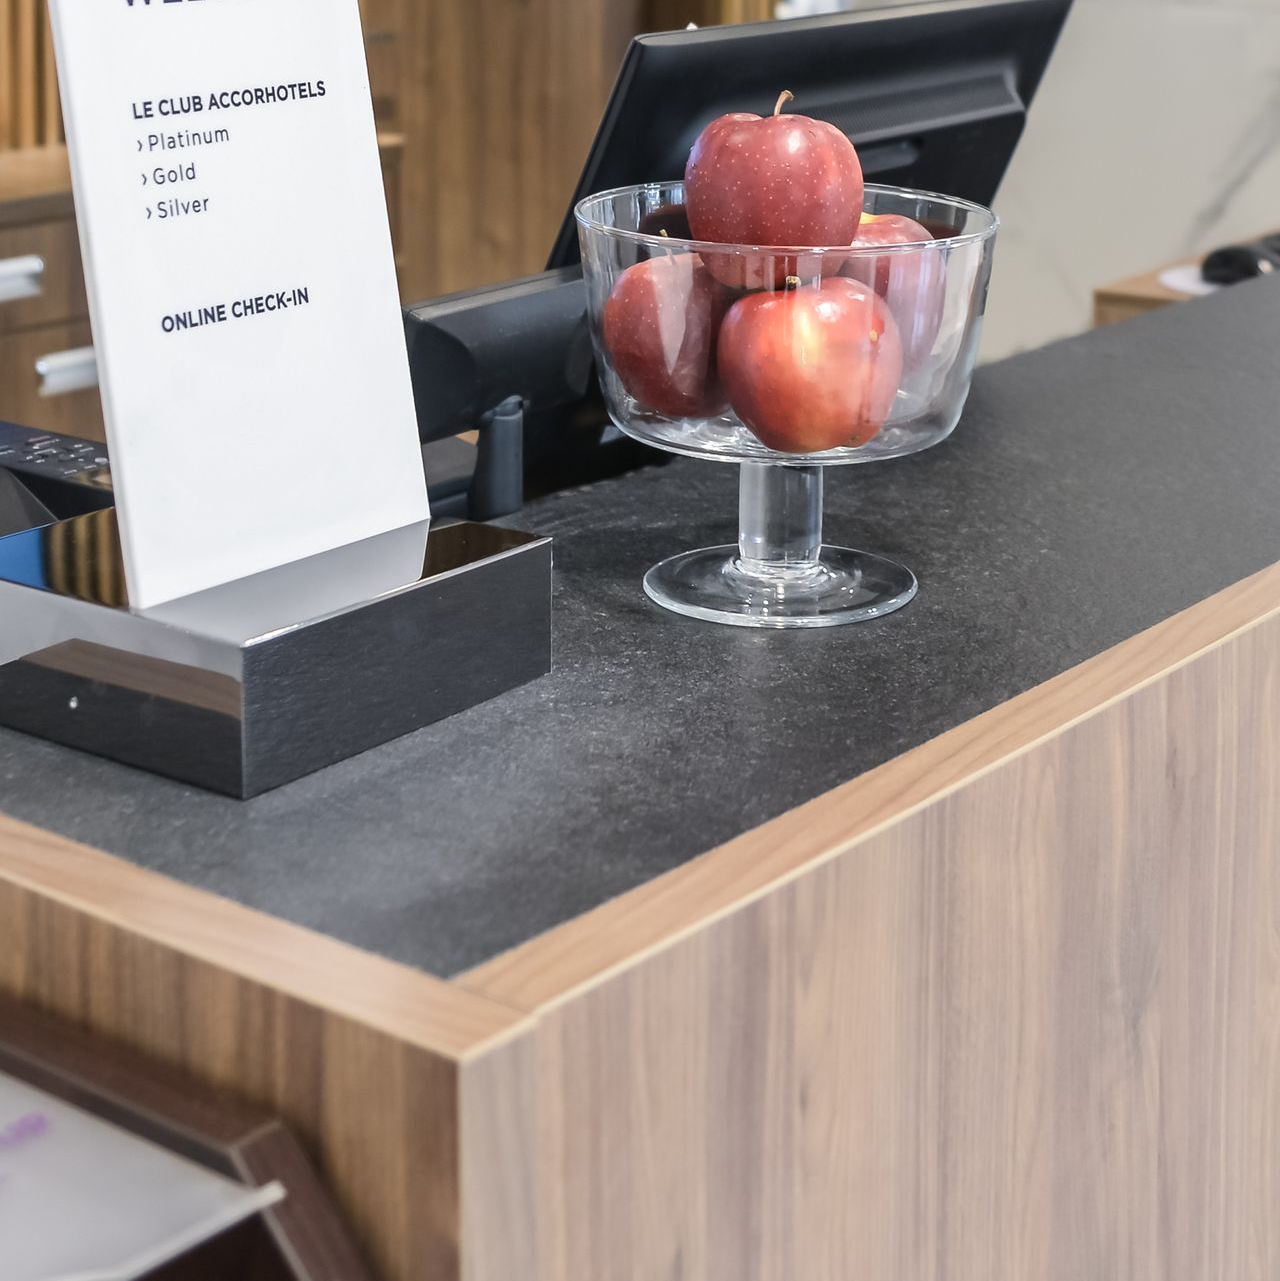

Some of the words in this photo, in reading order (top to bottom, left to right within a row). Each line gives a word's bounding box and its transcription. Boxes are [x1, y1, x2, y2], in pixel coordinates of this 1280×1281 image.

[132, 101, 154, 119] LE
[158, 95, 204, 117] CLUB
[208, 80, 327, 111] ACCORHOTELS
[148, 126, 230, 152] Platinum
[152, 162, 197, 185] Gold
[156, 196, 210, 219] Silver
[160, 304, 227, 333] ONLINE
[231, 287, 311, 319] CHECK-IN
